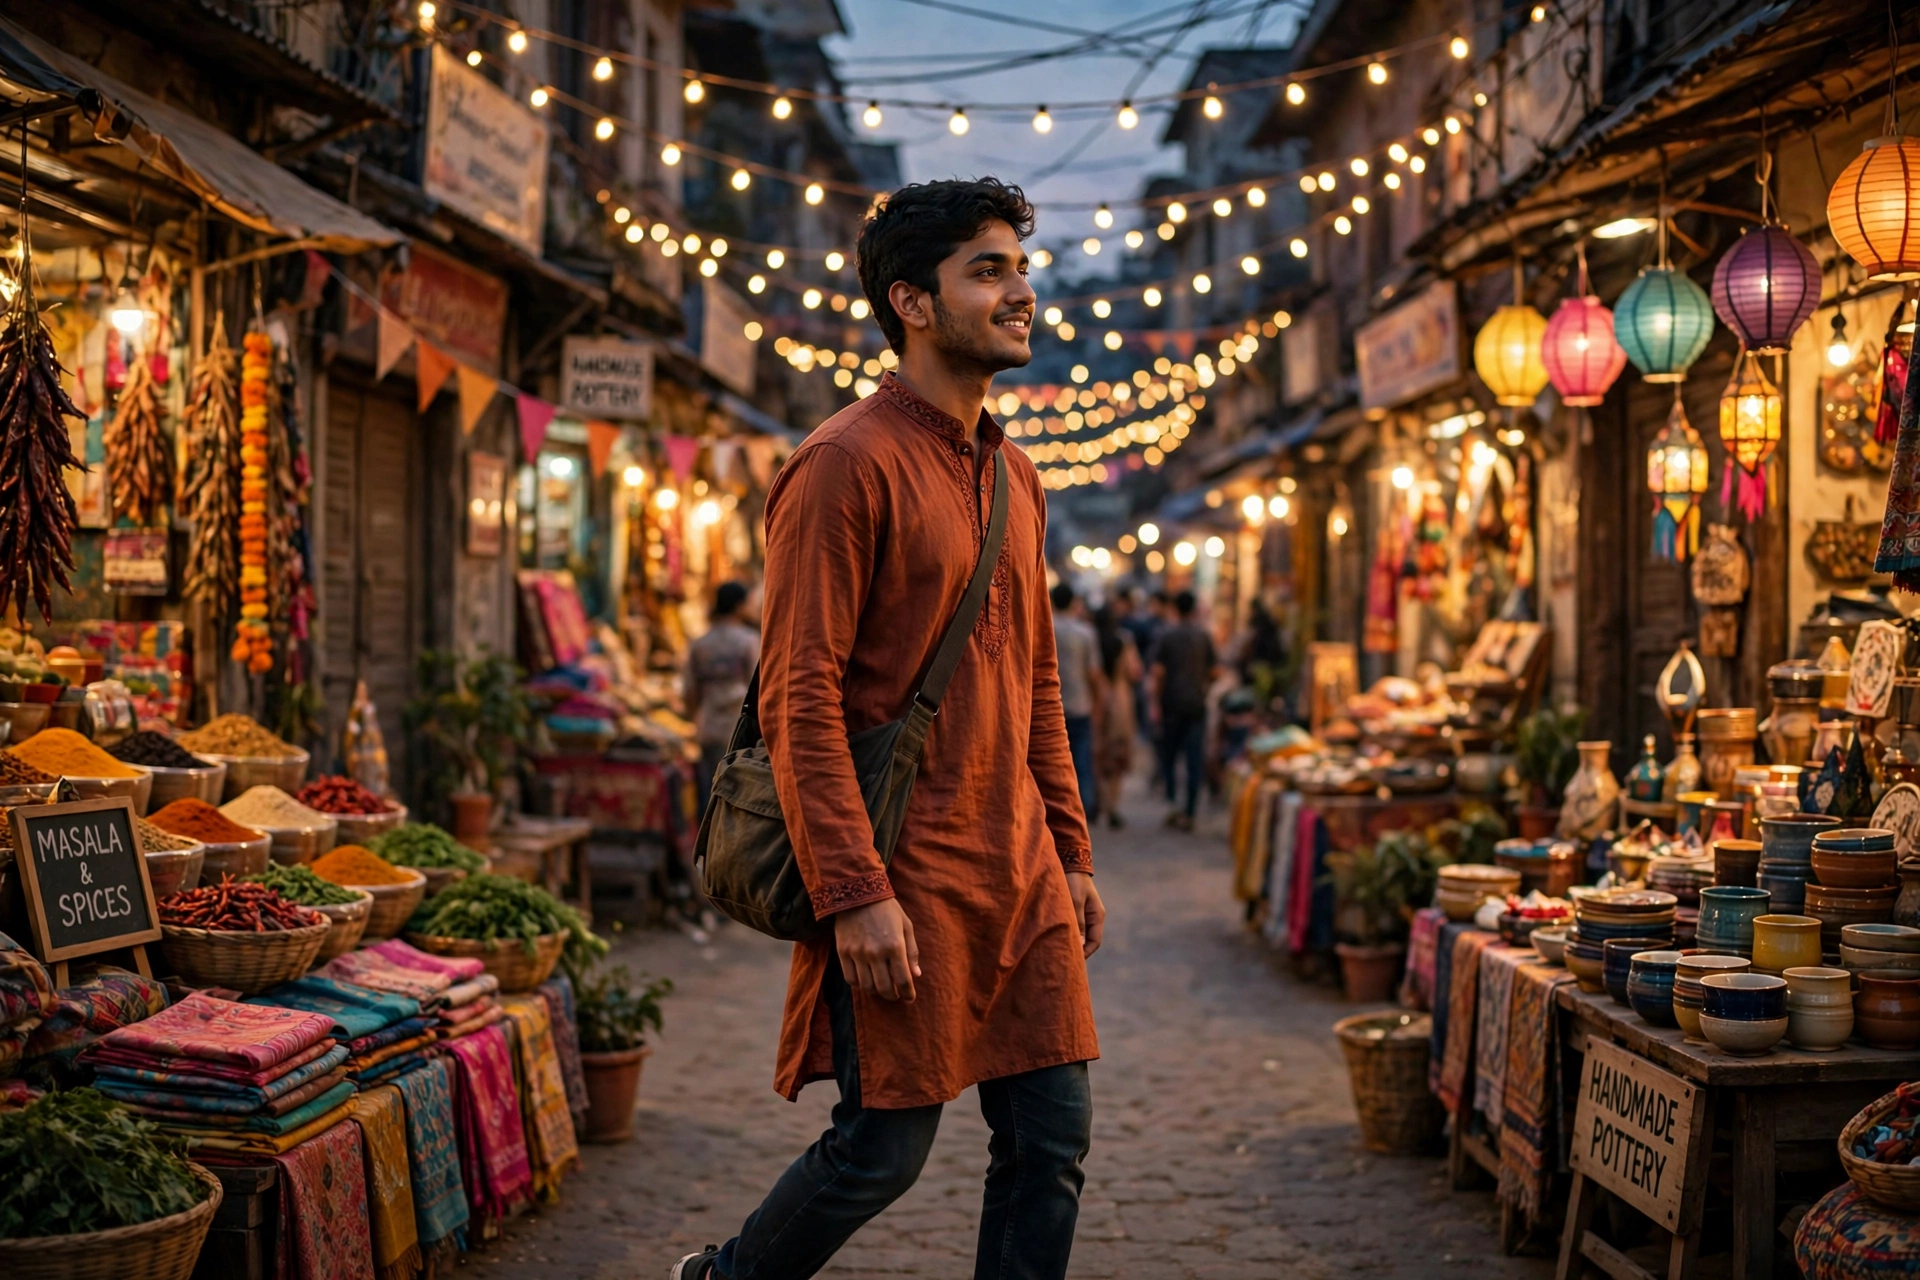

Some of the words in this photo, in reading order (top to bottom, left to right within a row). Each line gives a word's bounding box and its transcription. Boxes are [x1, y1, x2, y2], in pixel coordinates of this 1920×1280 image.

[37, 823, 123, 862] MASALA
[80, 861, 93, 885] &
[59, 884, 131, 927] SPICES
[1589, 1059, 1678, 1145] HANDMADE
[1590, 1116, 1667, 1198] POTTERY
